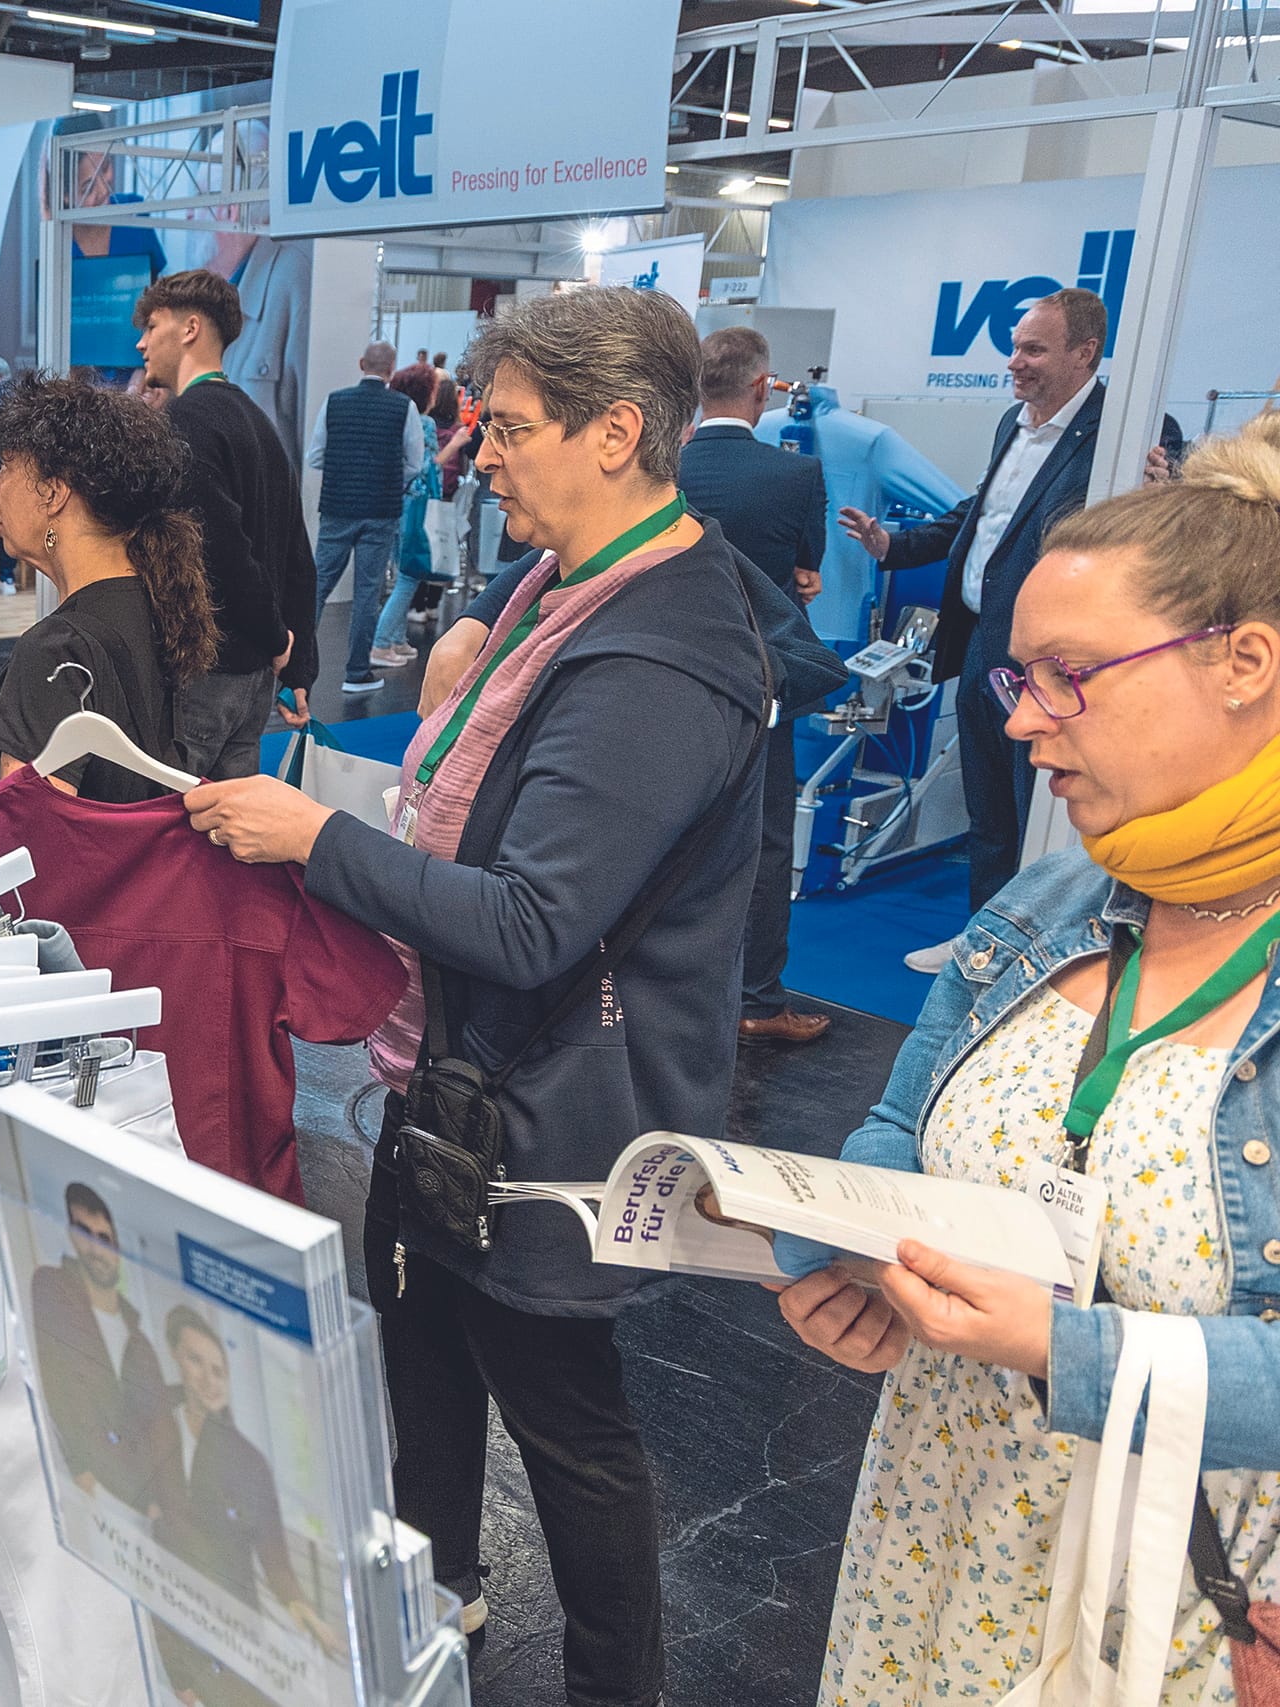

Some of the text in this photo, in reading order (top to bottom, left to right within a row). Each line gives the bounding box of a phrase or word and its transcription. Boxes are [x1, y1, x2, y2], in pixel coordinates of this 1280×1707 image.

[288, 69, 433, 205] veit
[451, 156, 648, 193] Pressing for Excellence
[927, 372, 998, 388] PRESSING
[614, 1145, 680, 1243] Berufsbe
[641, 1203, 666, 1243] für
[656, 1164, 686, 1197] die
[1055, 1197, 1085, 1216] PFLEGE
[1057, 1187, 1083, 1203] ALTEN
